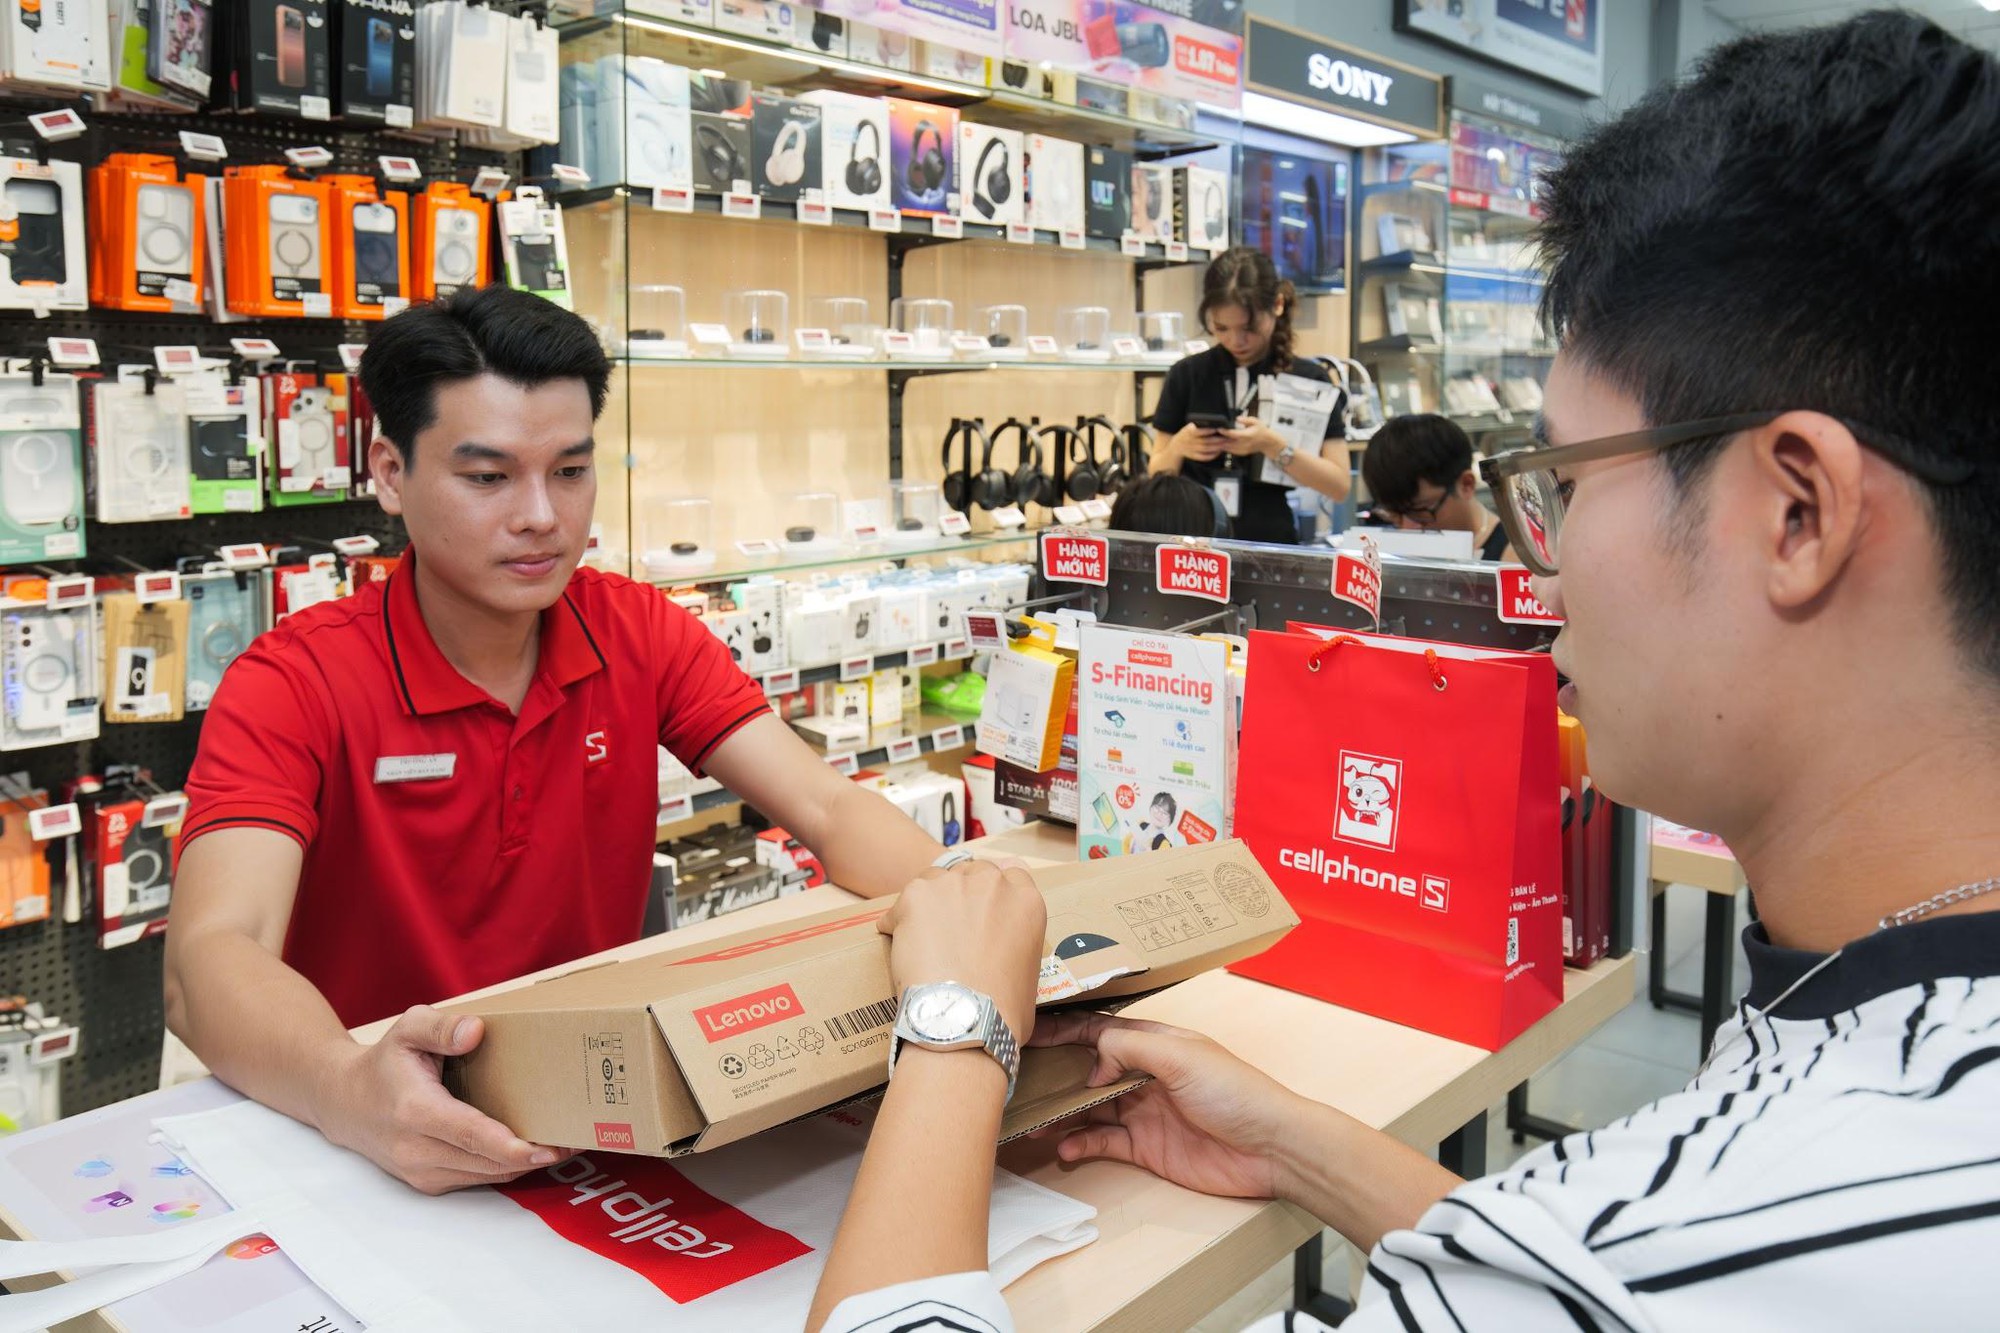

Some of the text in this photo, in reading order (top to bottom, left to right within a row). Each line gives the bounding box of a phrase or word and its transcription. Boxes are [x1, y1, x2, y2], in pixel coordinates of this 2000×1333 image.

[1010, 5, 1045, 32] LOA
[1051, 17, 1083, 44] JBL
[1308, 53, 1393, 106] SONY
[1059, 540, 1098, 558] HÀNG
[1057, 558, 1083, 576] MỚI
[1174, 553, 1219, 574] HÀNG
[1171, 570, 1201, 589] MỚI
[1352, 565, 1379, 592] HÀN
[1092, 662, 1213, 705] S-Financing
[585, 731, 607, 762] S
[1007, 782, 1031, 796] STAR
[1279, 847, 1417, 898] cellphone
[1423, 878, 1448, 910] S
[704, 995, 791, 1033] Lenovo
[598, 1126, 631, 1144] Lenovo
